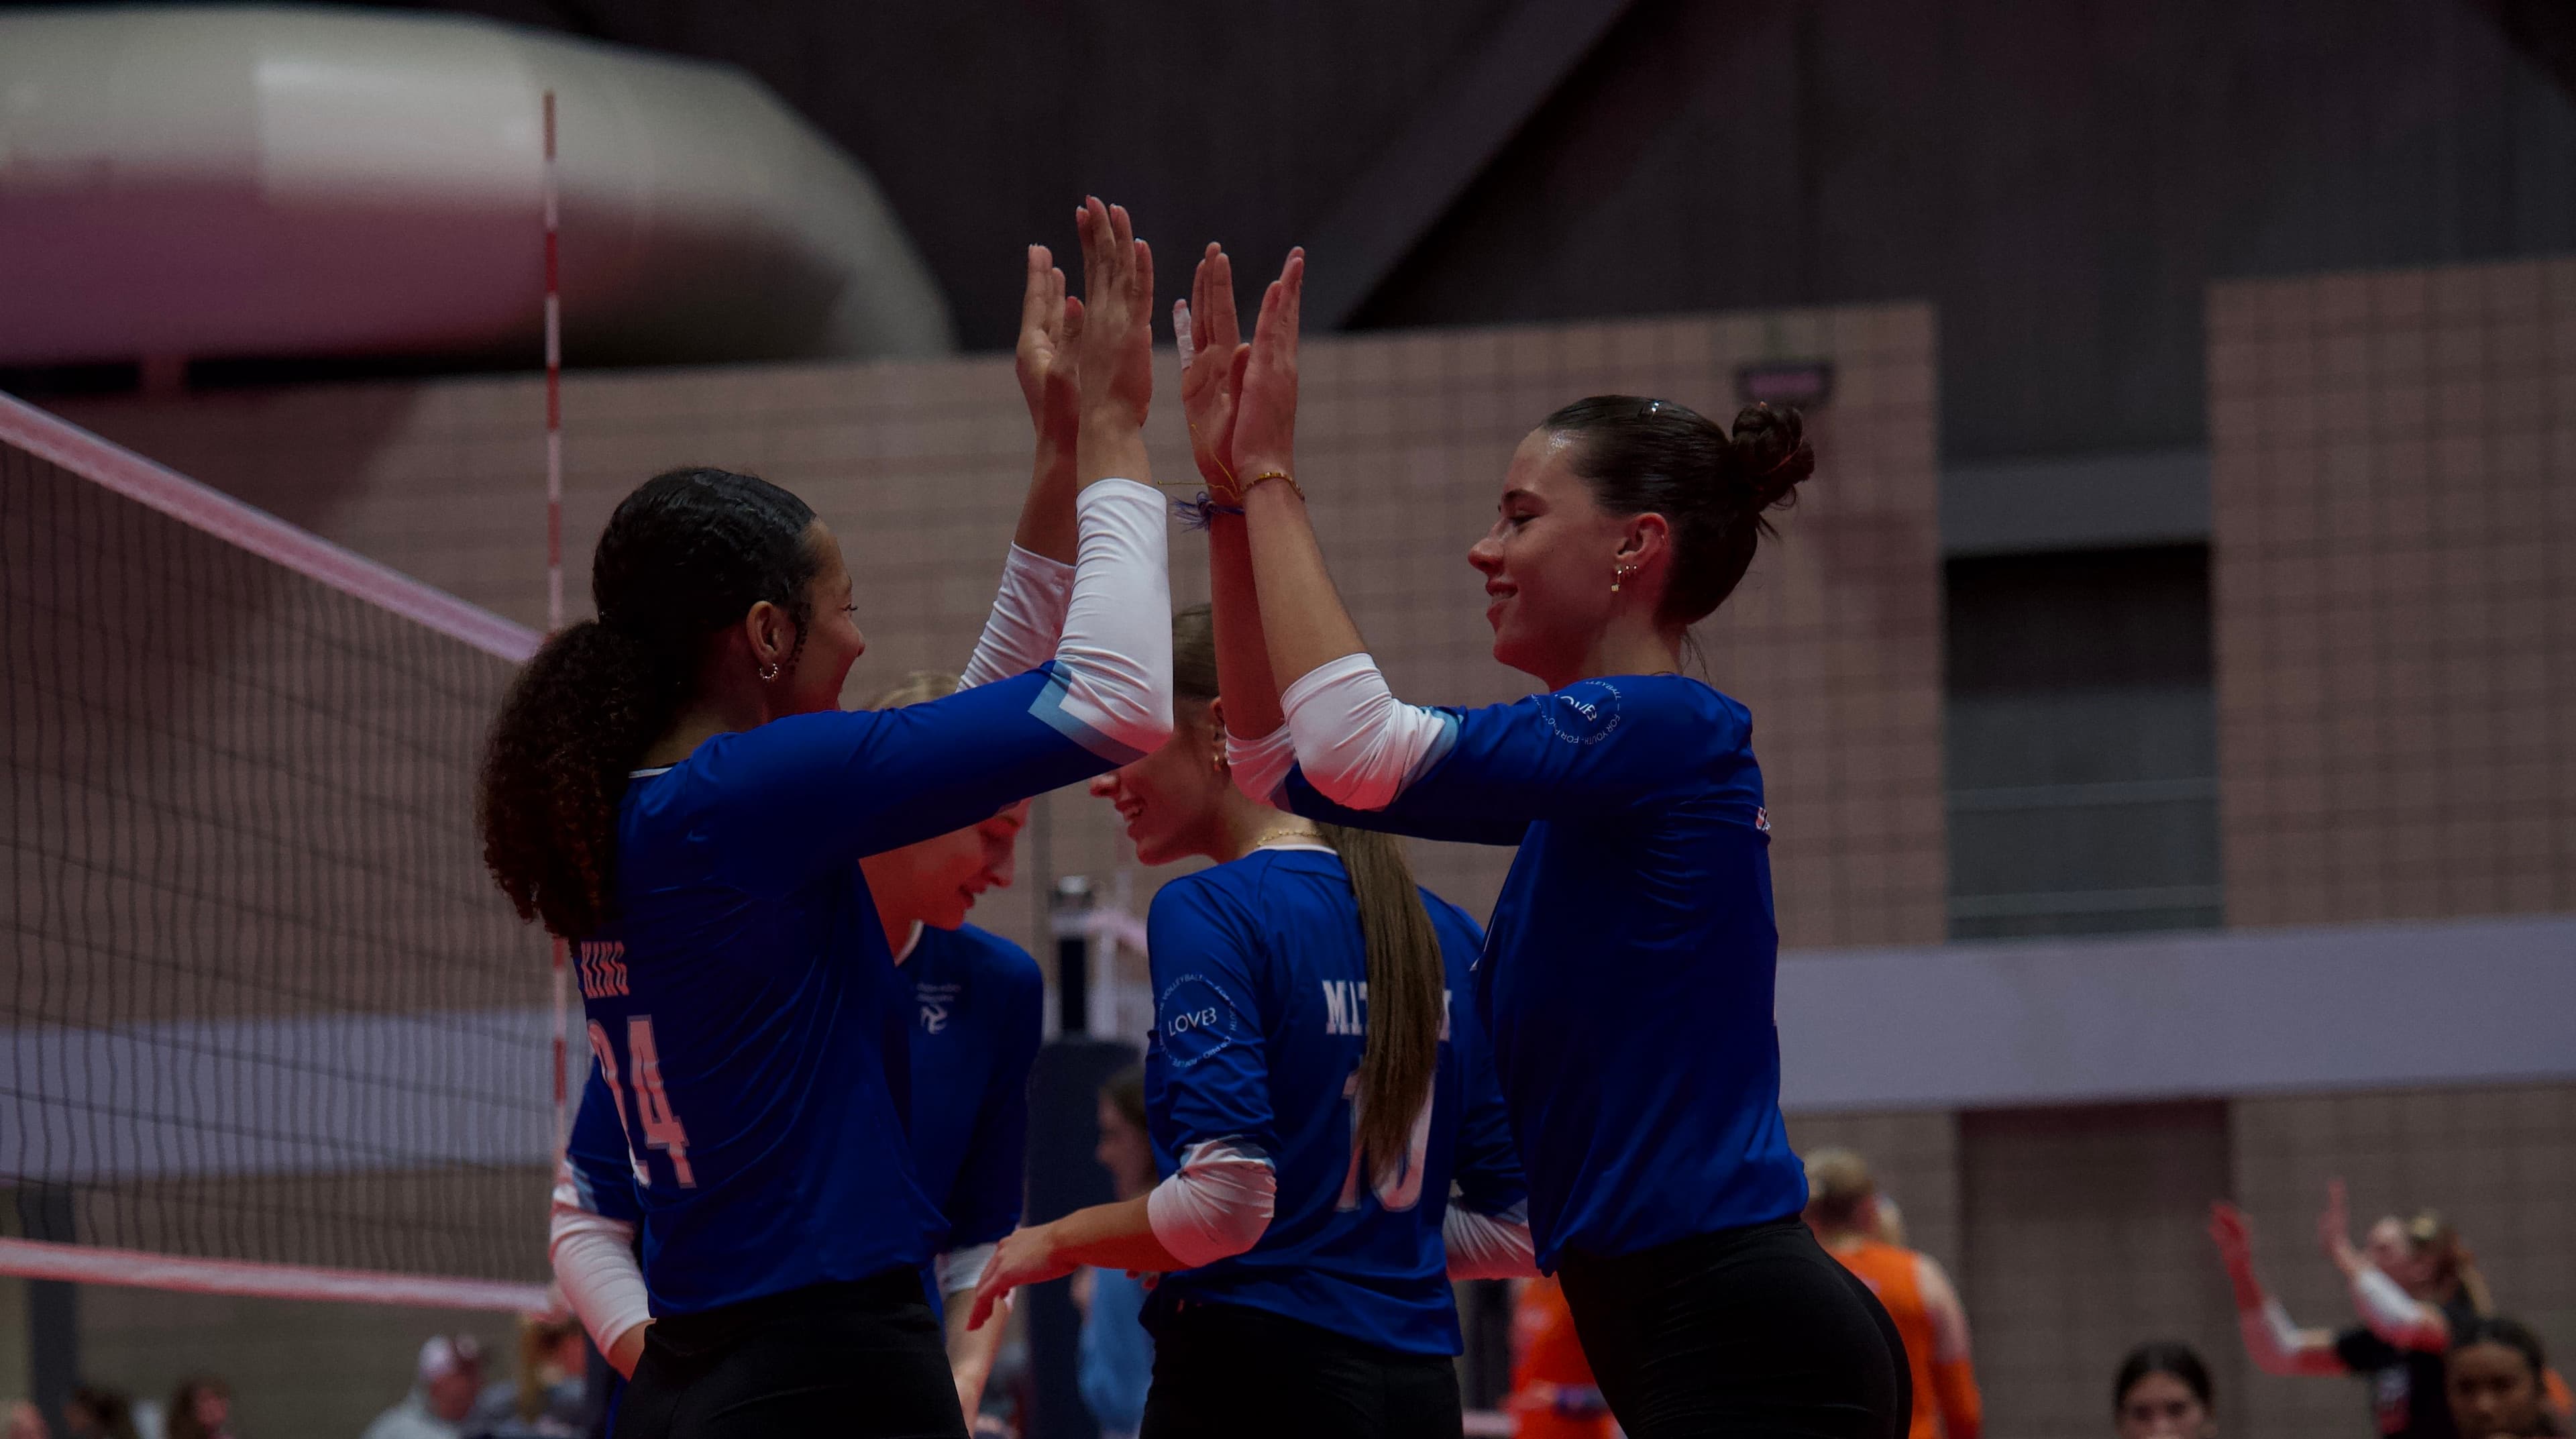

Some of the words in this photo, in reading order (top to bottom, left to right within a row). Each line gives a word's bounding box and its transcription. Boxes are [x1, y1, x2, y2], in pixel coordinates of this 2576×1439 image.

[1606, 713, 1621, 732] FOR
[1561, 733, 1579, 744] FOR
[1585, 731, 1608, 745] YOUTH
[581, 941, 631, 998] KING
